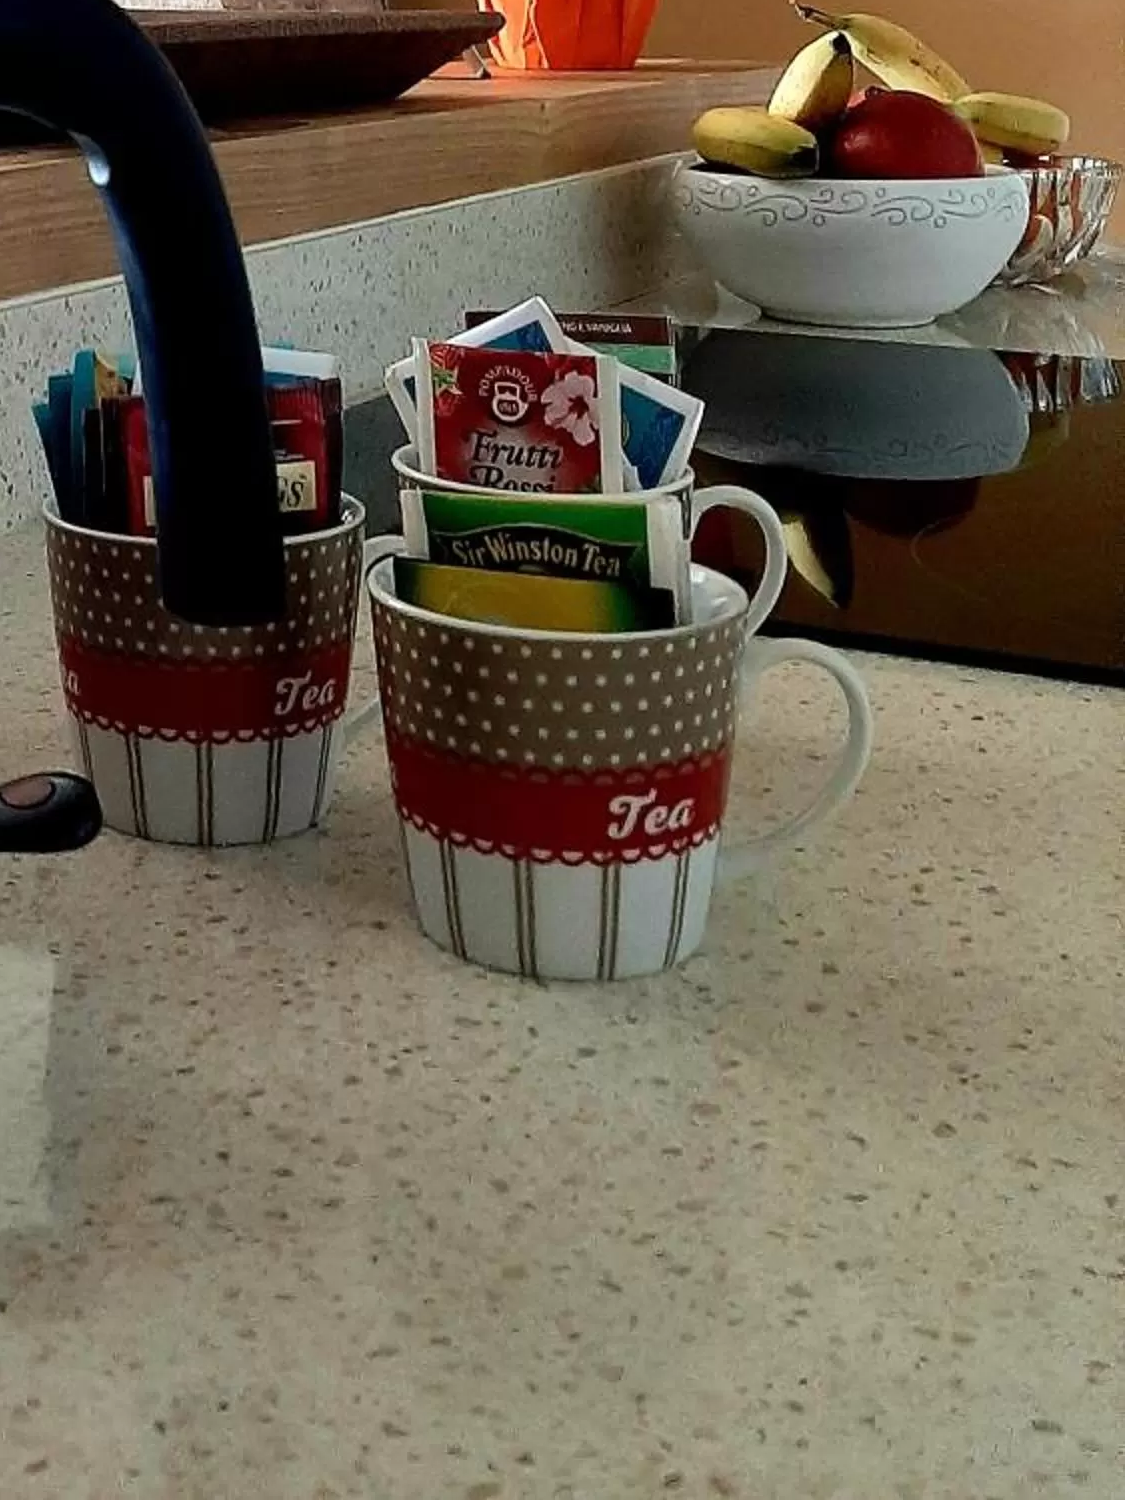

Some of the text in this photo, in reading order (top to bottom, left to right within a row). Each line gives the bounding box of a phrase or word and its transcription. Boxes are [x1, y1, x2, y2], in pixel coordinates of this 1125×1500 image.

[472, 428, 561, 469] Frutti
[452, 532, 620, 577] Sir Winston Tea
[276, 670, 335, 715] Tea
[607, 787, 695, 839] Tea
